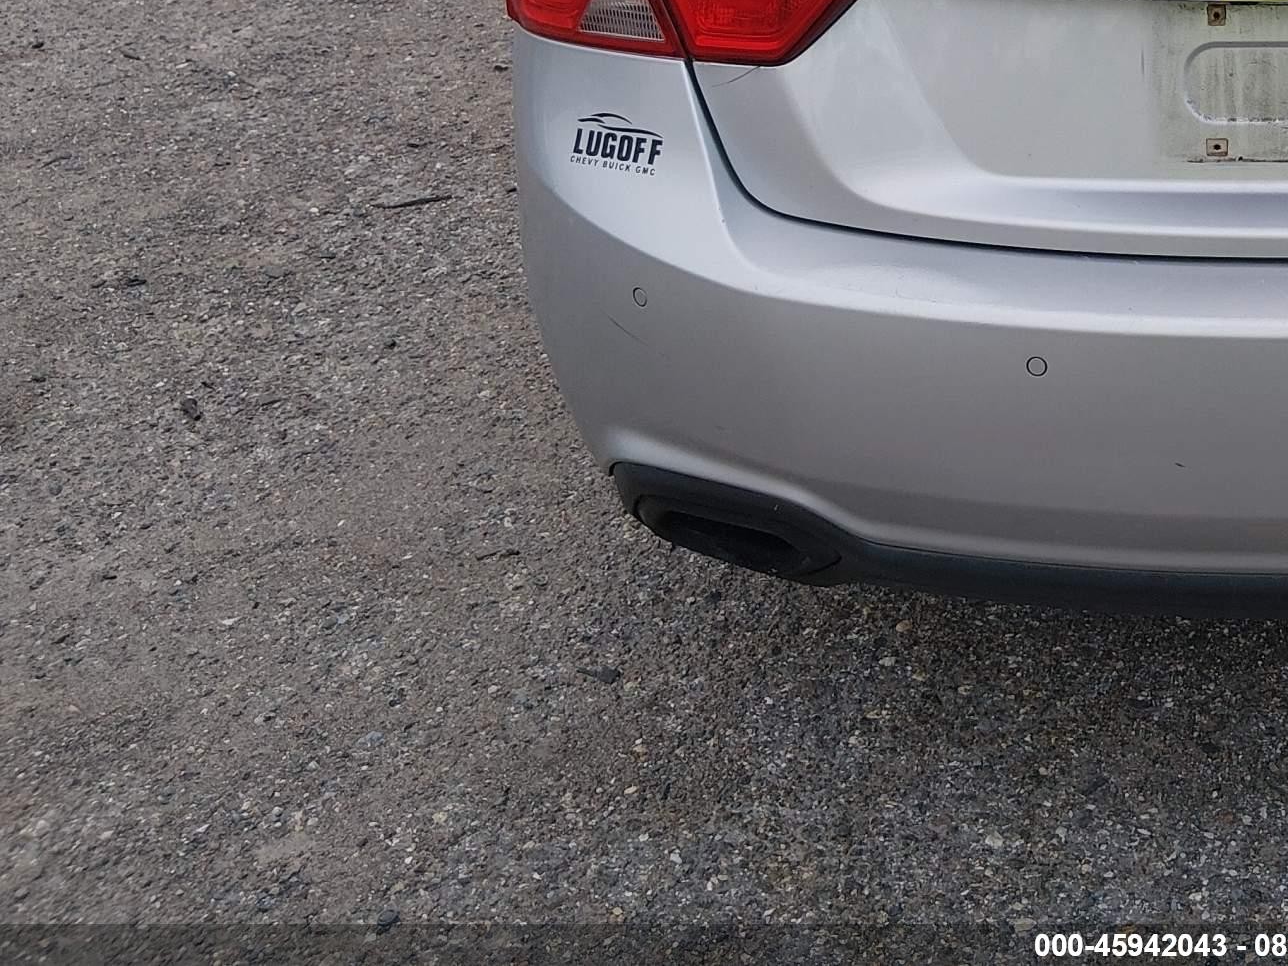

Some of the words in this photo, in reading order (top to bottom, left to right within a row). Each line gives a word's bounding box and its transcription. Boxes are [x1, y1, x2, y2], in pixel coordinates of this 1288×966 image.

[572, 128, 663, 165] LUGOFF
[570, 155, 600, 167] CHEVY
[602, 160, 632, 172] BUICK
[635, 165, 657, 177] GMC
